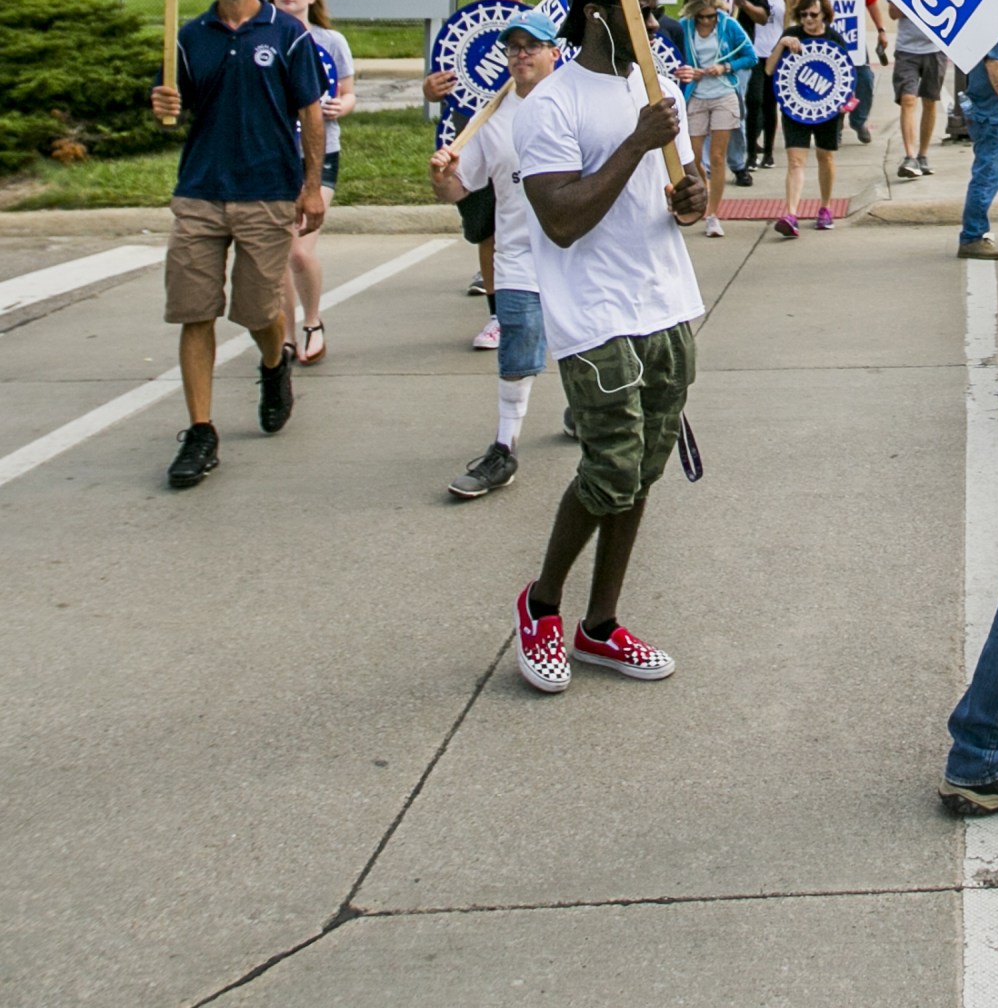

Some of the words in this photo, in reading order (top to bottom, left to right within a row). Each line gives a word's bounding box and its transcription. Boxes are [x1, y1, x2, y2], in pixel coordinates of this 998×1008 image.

[833, 0, 856, 14] AW
[474, 39, 509, 86] AW
[797, 65, 833, 96] UAW
